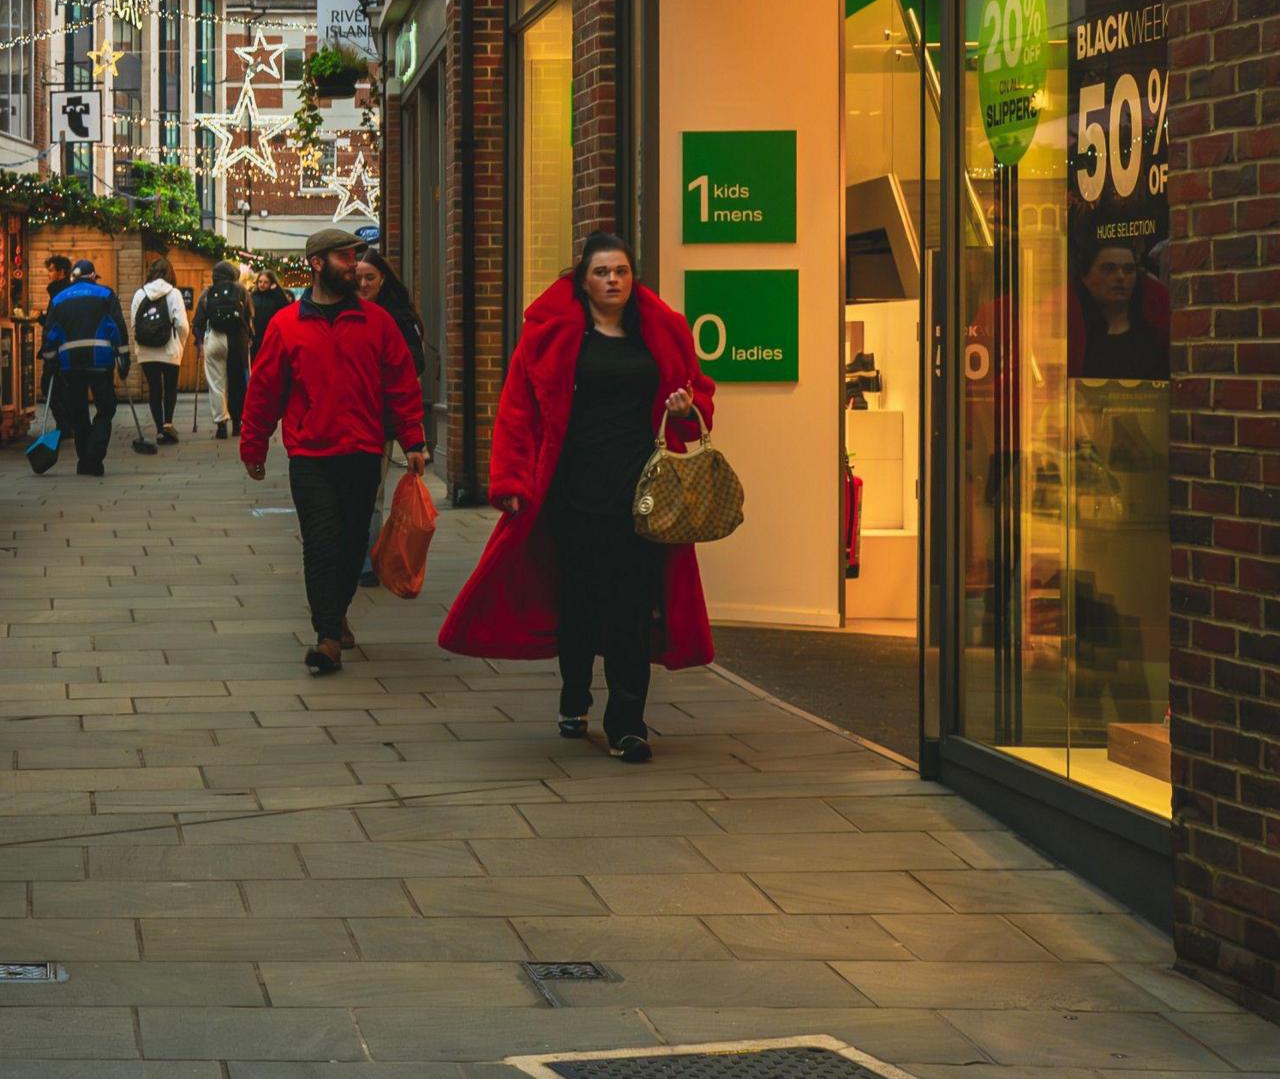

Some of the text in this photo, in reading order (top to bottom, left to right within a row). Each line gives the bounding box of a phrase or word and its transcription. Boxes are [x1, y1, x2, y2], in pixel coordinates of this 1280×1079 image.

[1023, 46, 1042, 66] OFF
[688, 175, 750, 223] 1 kids
[714, 209, 764, 222] mens
[1116, 220, 1156, 238] SELECTION
[692, 313, 784, 362] 0 ladies
